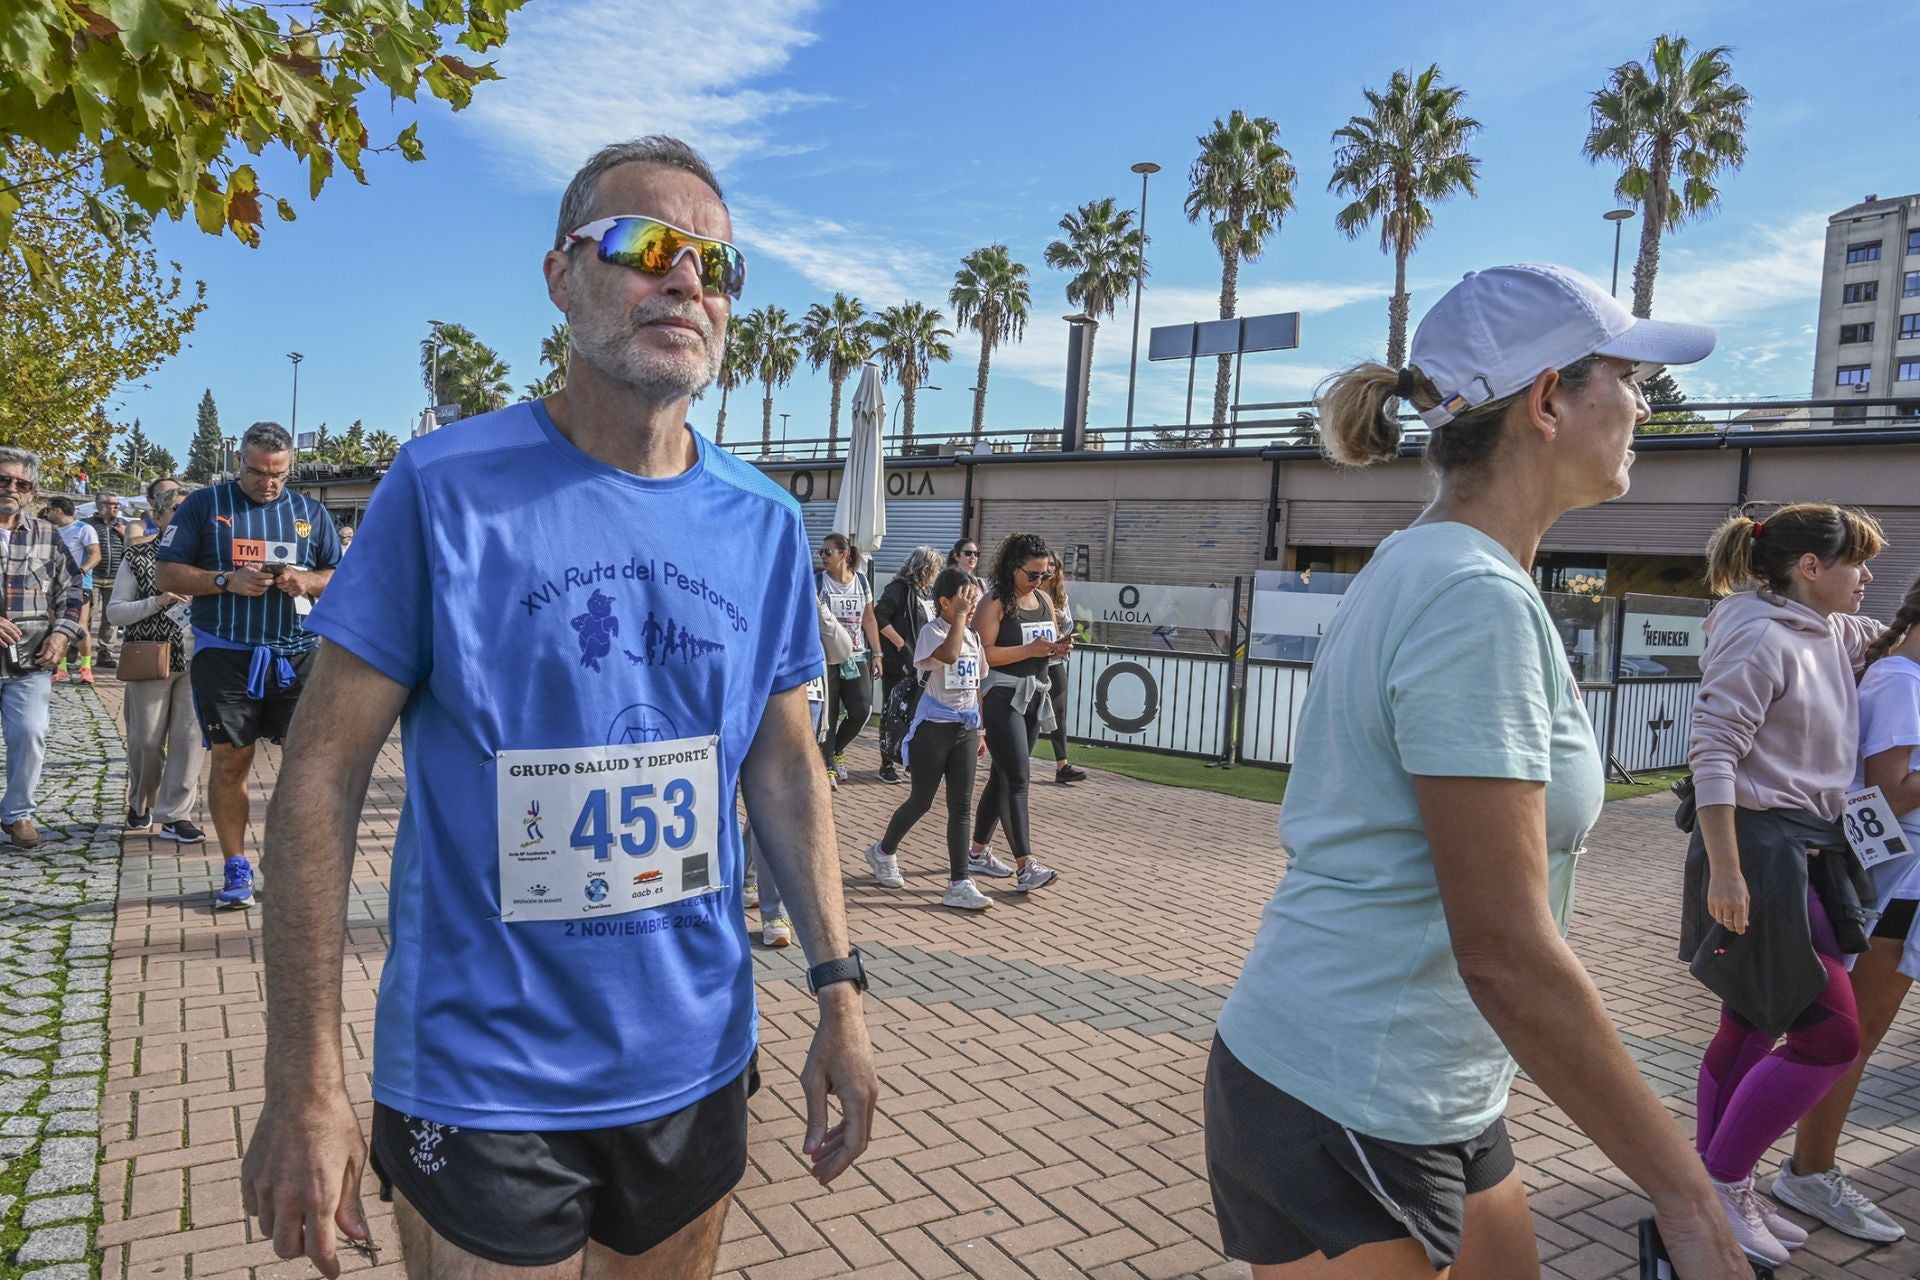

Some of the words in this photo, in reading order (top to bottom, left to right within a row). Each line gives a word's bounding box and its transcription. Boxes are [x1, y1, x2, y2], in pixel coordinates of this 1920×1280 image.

[237, 544, 259, 557] TM
[520, 580, 561, 616] XVI
[564, 560, 616, 592] Ruta
[622, 557, 655, 582] del
[664, 562, 748, 633] Pestorejo
[839, 599, 858, 611] 197
[1103, 611, 1152, 624] LALOLA
[1645, 630, 1690, 647] HEINEKEN
[957, 660, 977, 677] 541
[509, 763, 571, 778] GRUPO
[574, 758, 629, 775] SALUD
[632, 756, 645, 769] Y
[647, 748, 709, 768] DEPORTE
[1848, 792, 1878, 805] EPORTE
[569, 777, 698, 861] 453
[564, 922, 576, 937] 2
[581, 916, 669, 937] NOVIEMBRE
[673, 913, 711, 929] 2024
